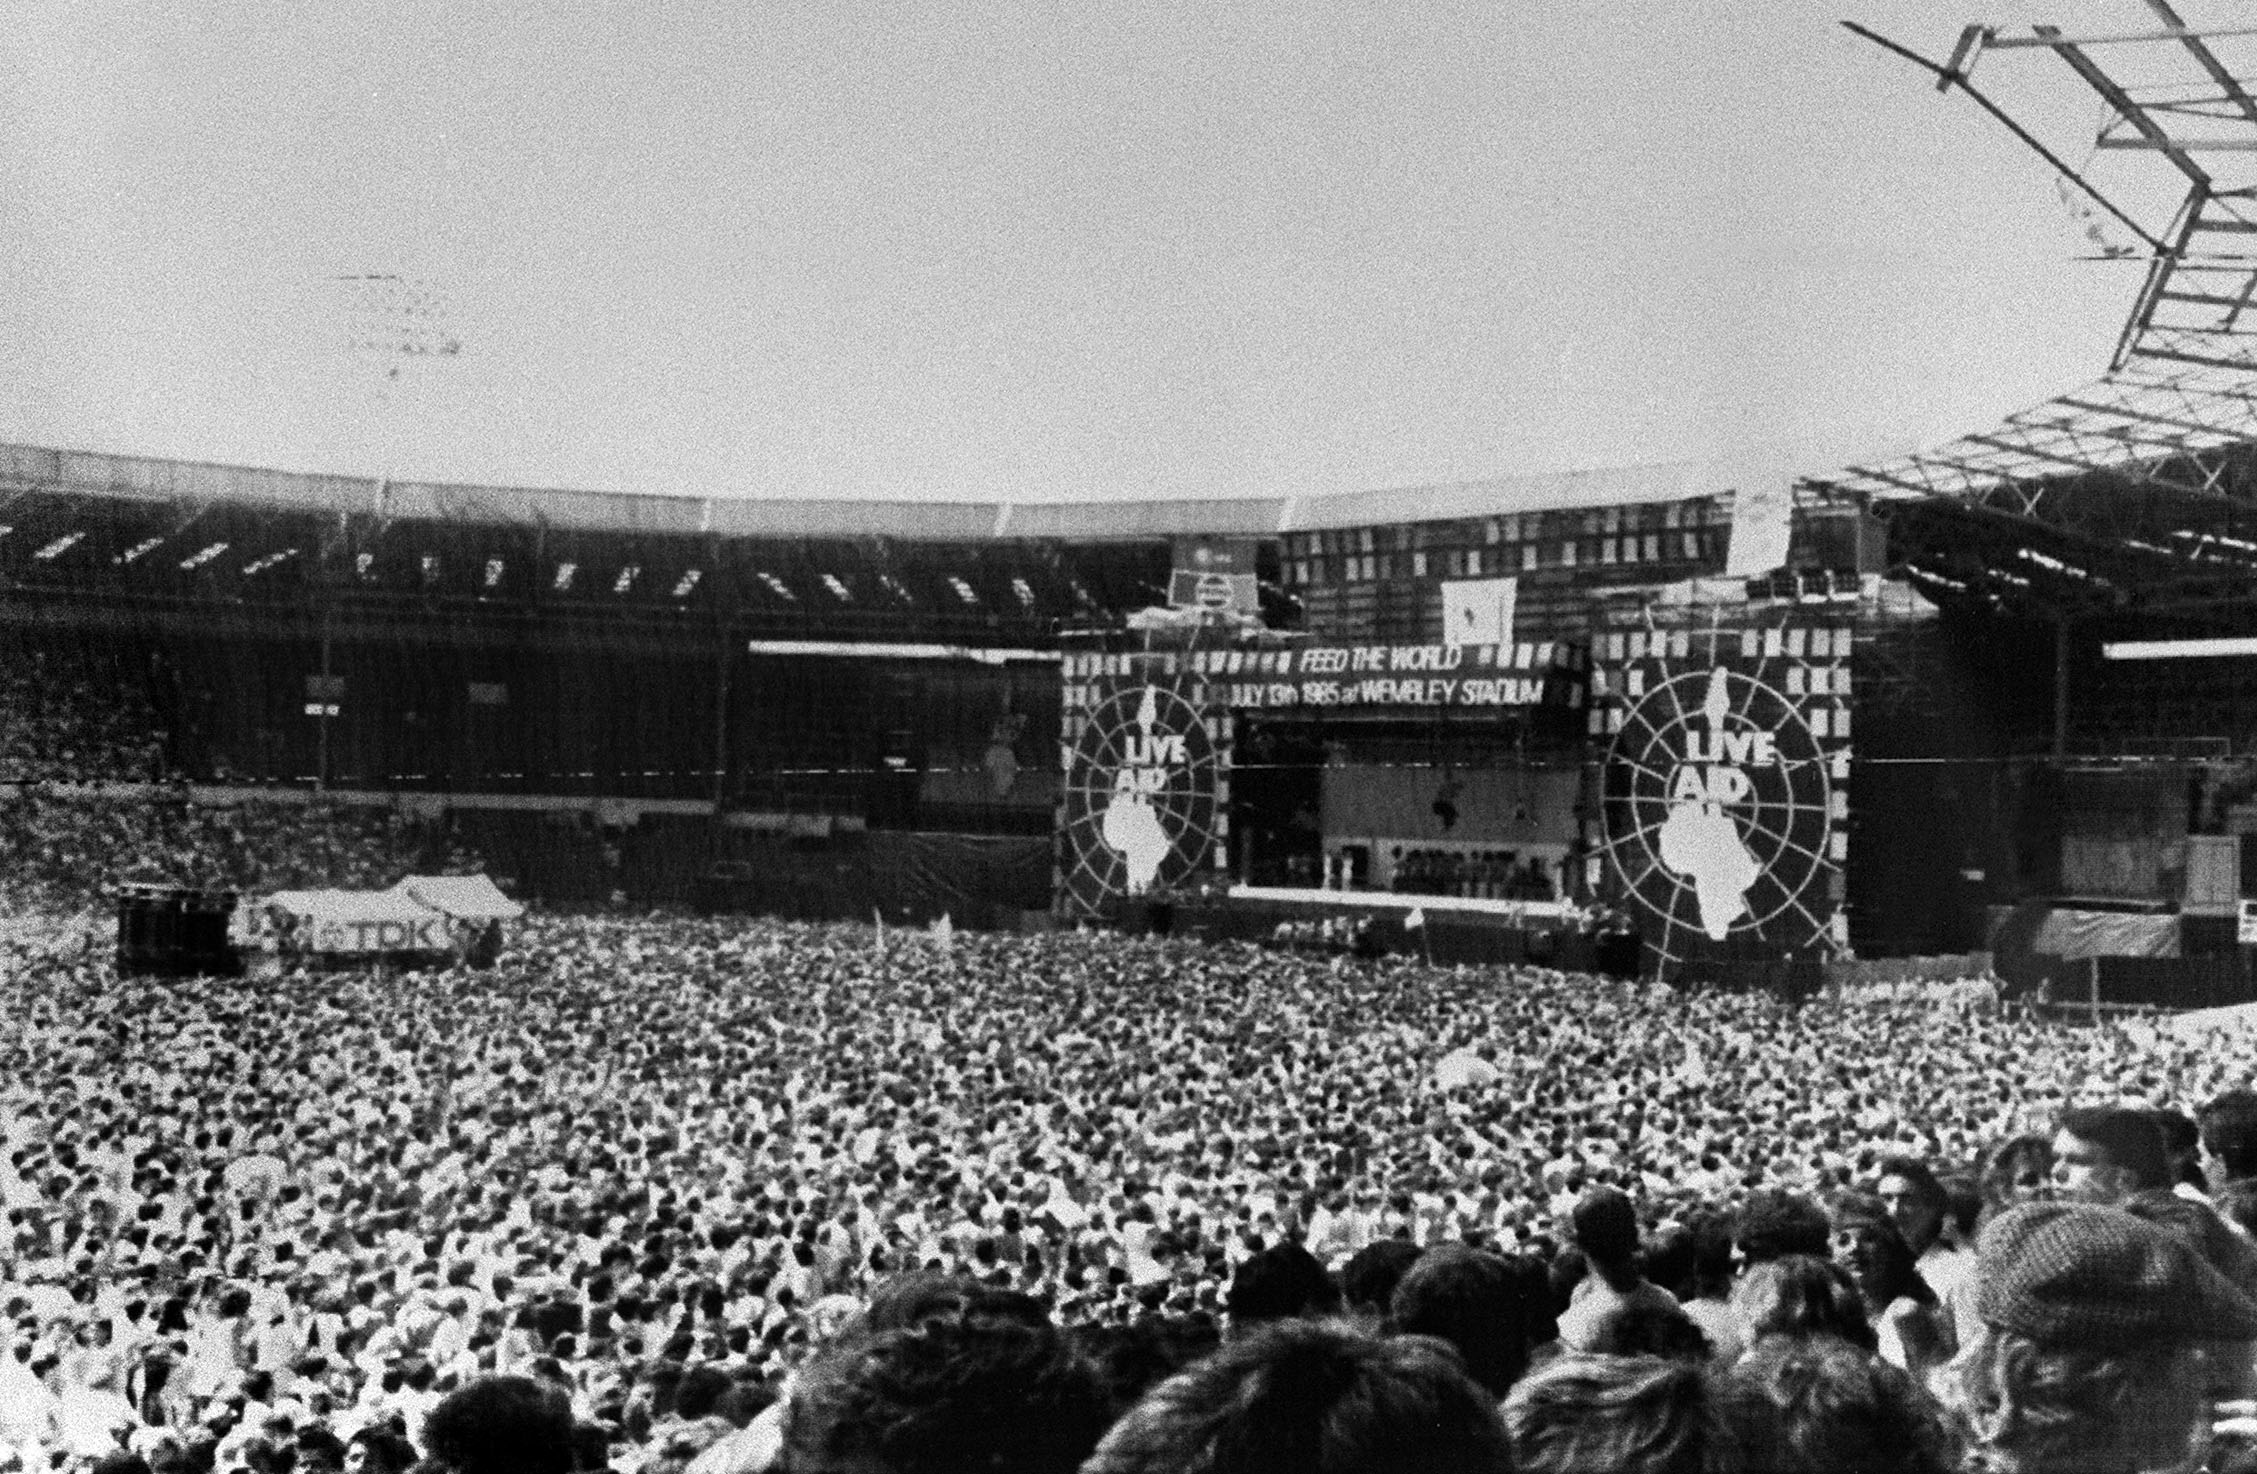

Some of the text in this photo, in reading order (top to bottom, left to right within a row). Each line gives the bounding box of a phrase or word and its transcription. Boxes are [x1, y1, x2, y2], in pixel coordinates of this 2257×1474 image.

[1301, 645, 1463, 673] FEED THE WORLD
[1361, 679, 1458, 705] WEMBLEY
[1460, 678, 1545, 705] STADIUM
[1125, 735, 1186, 764] LIVE
[1685, 730, 1776, 767] LIVE
[1115, 767, 1167, 795] AID
[1673, 765, 1751, 803] AID
[348, 920, 437, 950] TDK
